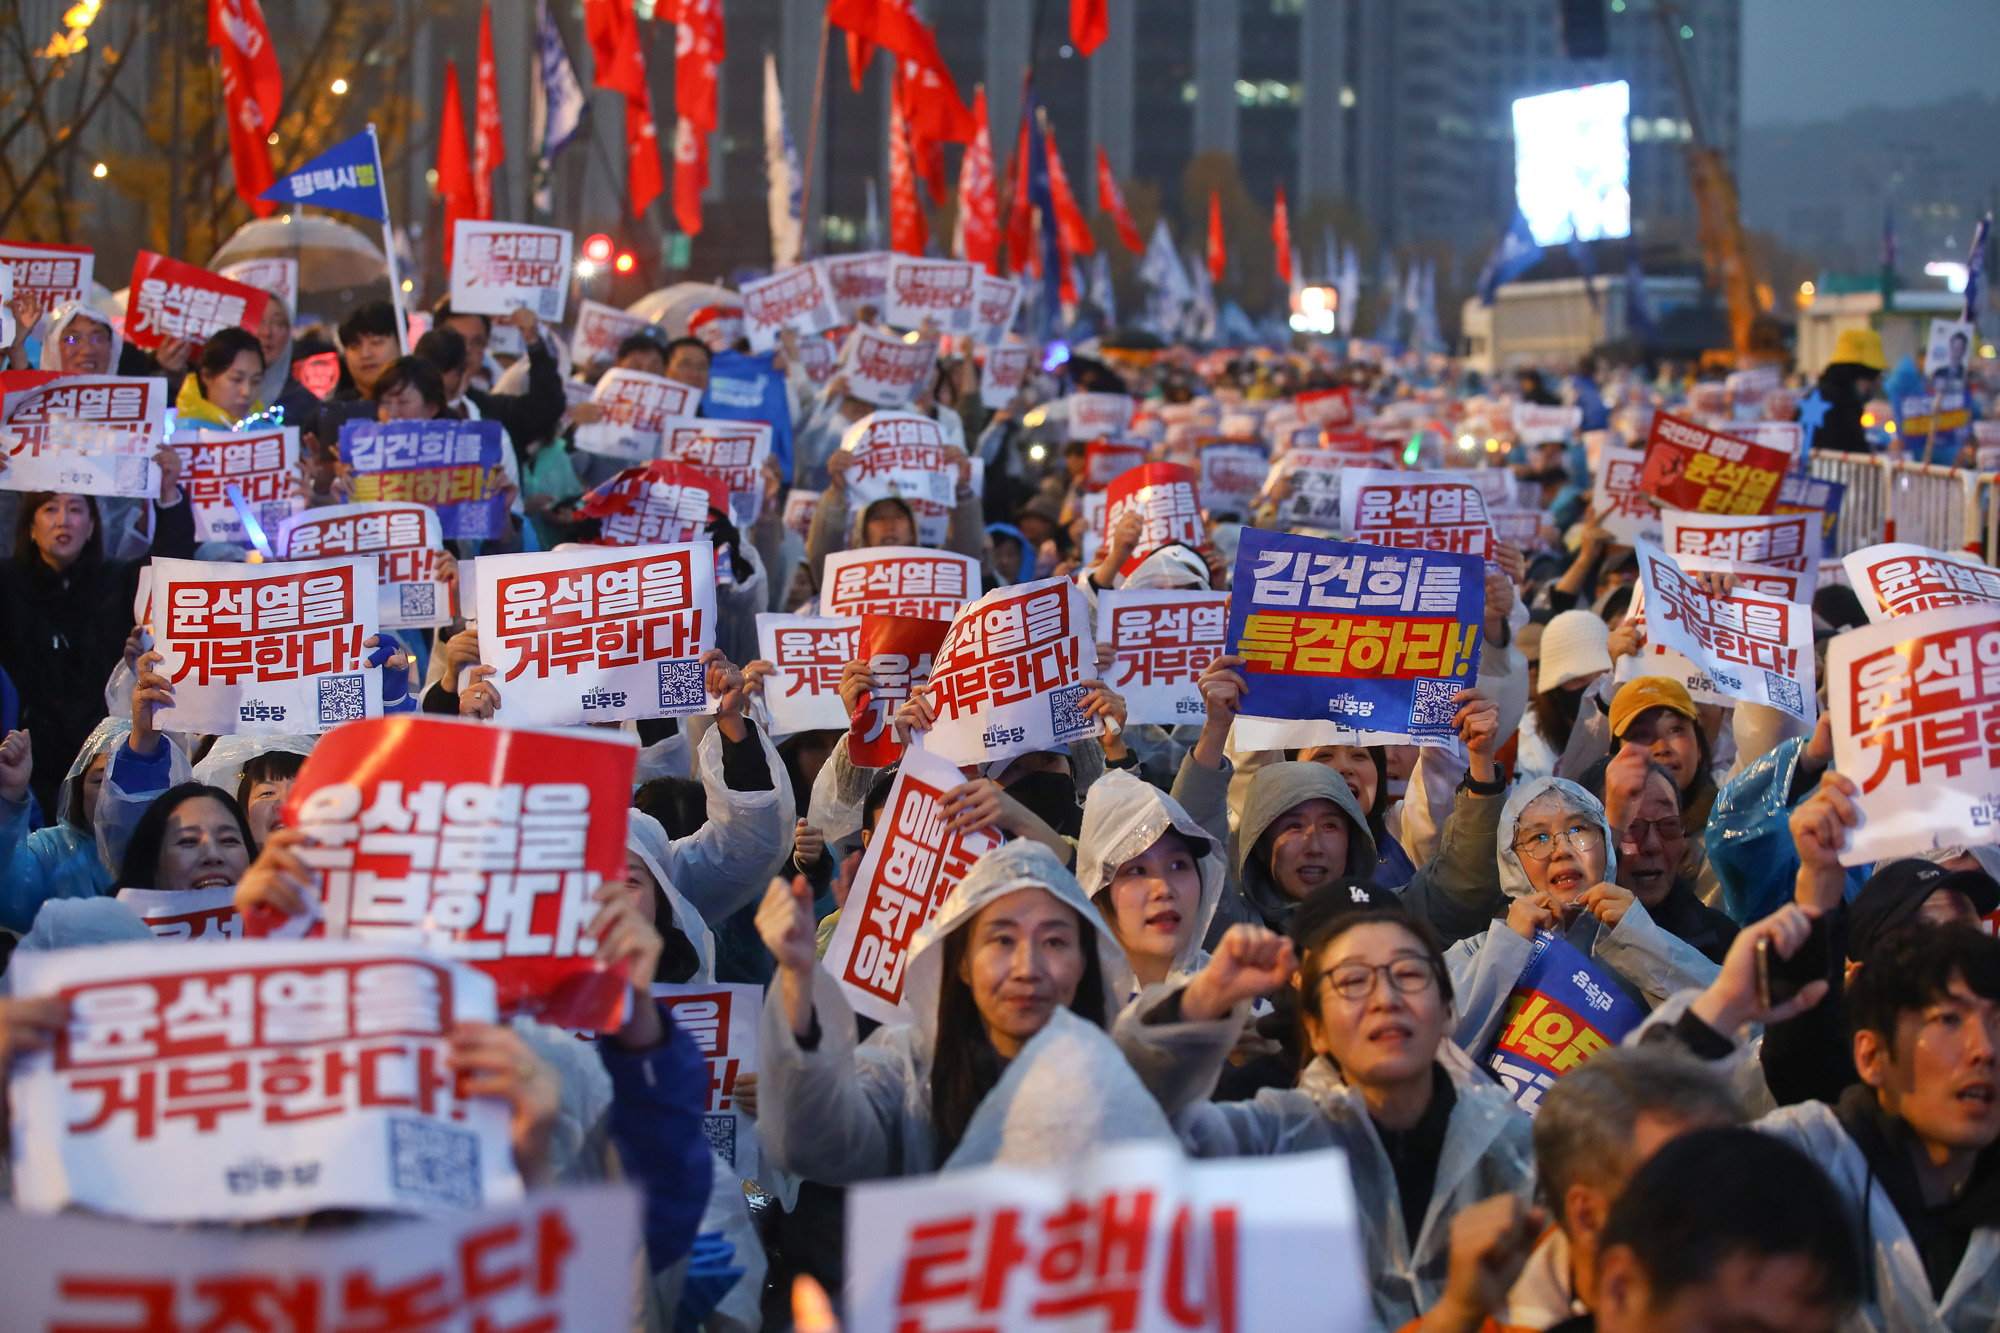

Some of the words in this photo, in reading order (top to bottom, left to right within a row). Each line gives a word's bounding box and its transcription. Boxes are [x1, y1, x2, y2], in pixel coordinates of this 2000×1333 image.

[10, 260, 76, 287] 석열을
[351, 431, 482, 471] 김건희를
[1684, 451, 1780, 492] 윤석열
[186, 471, 291, 509] 부한다!
[1361, 488, 1485, 526] 윤석열을
[290, 513, 421, 559] 윤석열을
[503, 560, 684, 629] 윤석열을
[836, 561, 964, 600] 윤석열을
[1252, 551, 1462, 612] 김건희를
[1653, 563, 1783, 641] 윤석열을
[172, 574, 345, 633] 윤석열을
[505, 609, 702, 683] 거부한다!
[930, 592, 1062, 678] 윤석열을
[1117, 606, 1231, 647] 윤석열
[1237, 614, 1479, 677] 특검하라!
[171, 625, 363, 686] 거부한다!
[581, 692, 627, 710] 민주당
[930, 637, 1080, 724] 거부한다!
[240, 706, 286, 721] 민주당
[659, 707, 707, 715] sign.theminjoo.kr
[1328, 698, 1375, 717] 민주당
[982, 727, 1025, 749] 민주당
[1861, 702, 2000, 795] 거부
[853, 789, 948, 994] 윤석열을
[1349, 886, 1370, 903] LA
[318, 870, 601, 960] 부한다!
[67, 962, 444, 1063] 윤석열을
[1572, 970, 1614, 1012] 민주당
